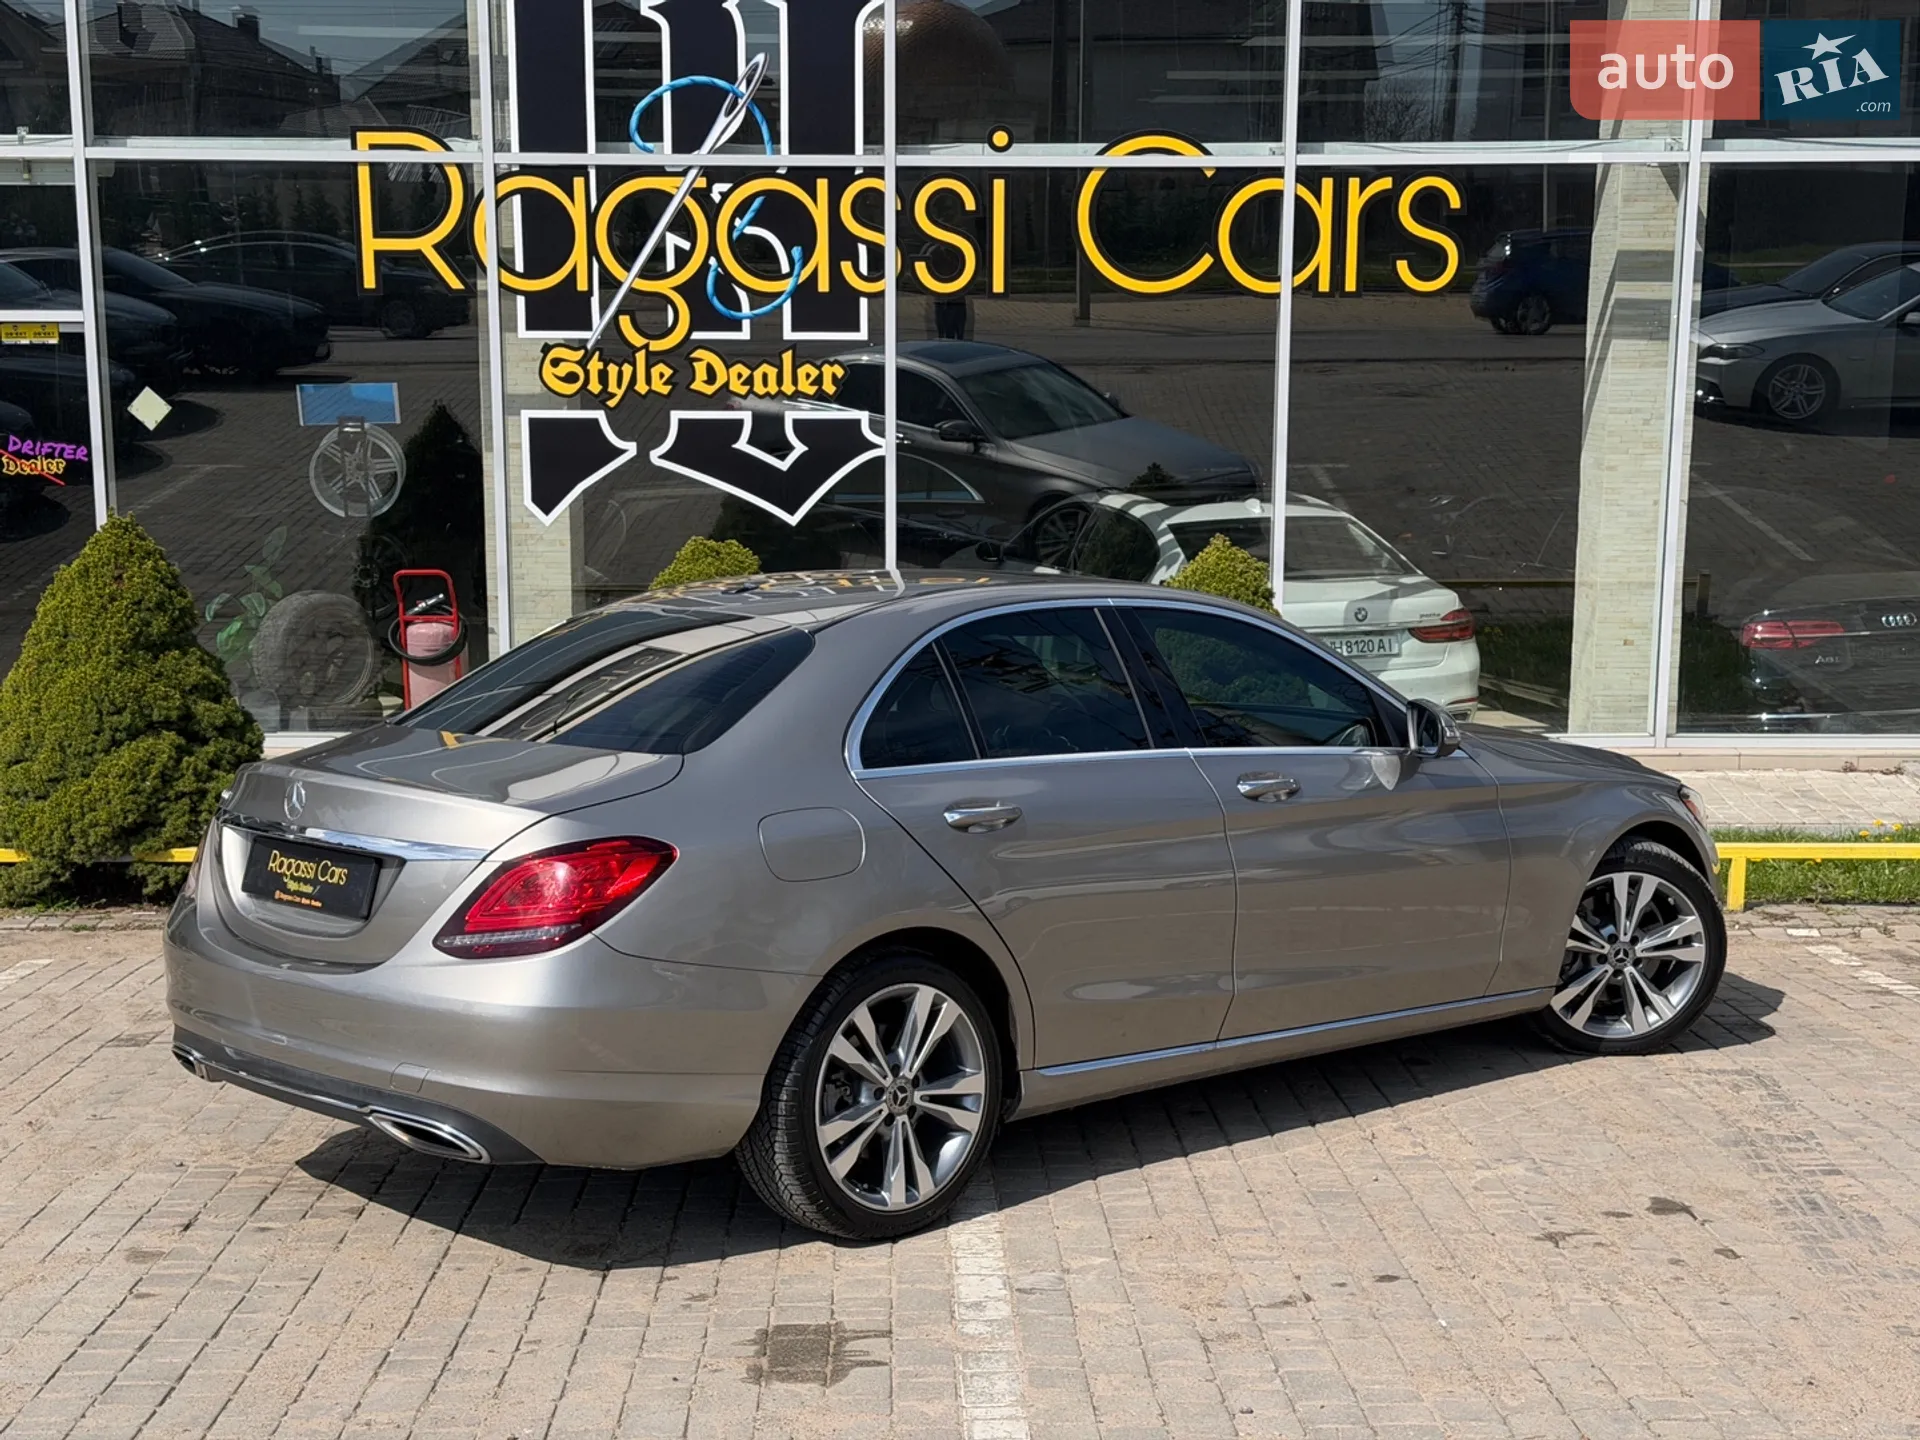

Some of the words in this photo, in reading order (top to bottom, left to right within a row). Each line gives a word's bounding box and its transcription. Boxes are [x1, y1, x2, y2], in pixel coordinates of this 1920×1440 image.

[357, 130, 1007, 352] Ragassi
[1076, 134, 1462, 294] Cars
[541, 346, 674, 409] Style
[687, 347, 846, 397] Dealer
[8, 434, 89, 462] DRIFTER
[1, 454, 67, 475] Dealer
[1345, 639, 1374, 654] 8120
[1378, 638, 1392, 653] AI
[267, 850, 317, 882] Ragassi
[318, 860, 348, 885] Cars
